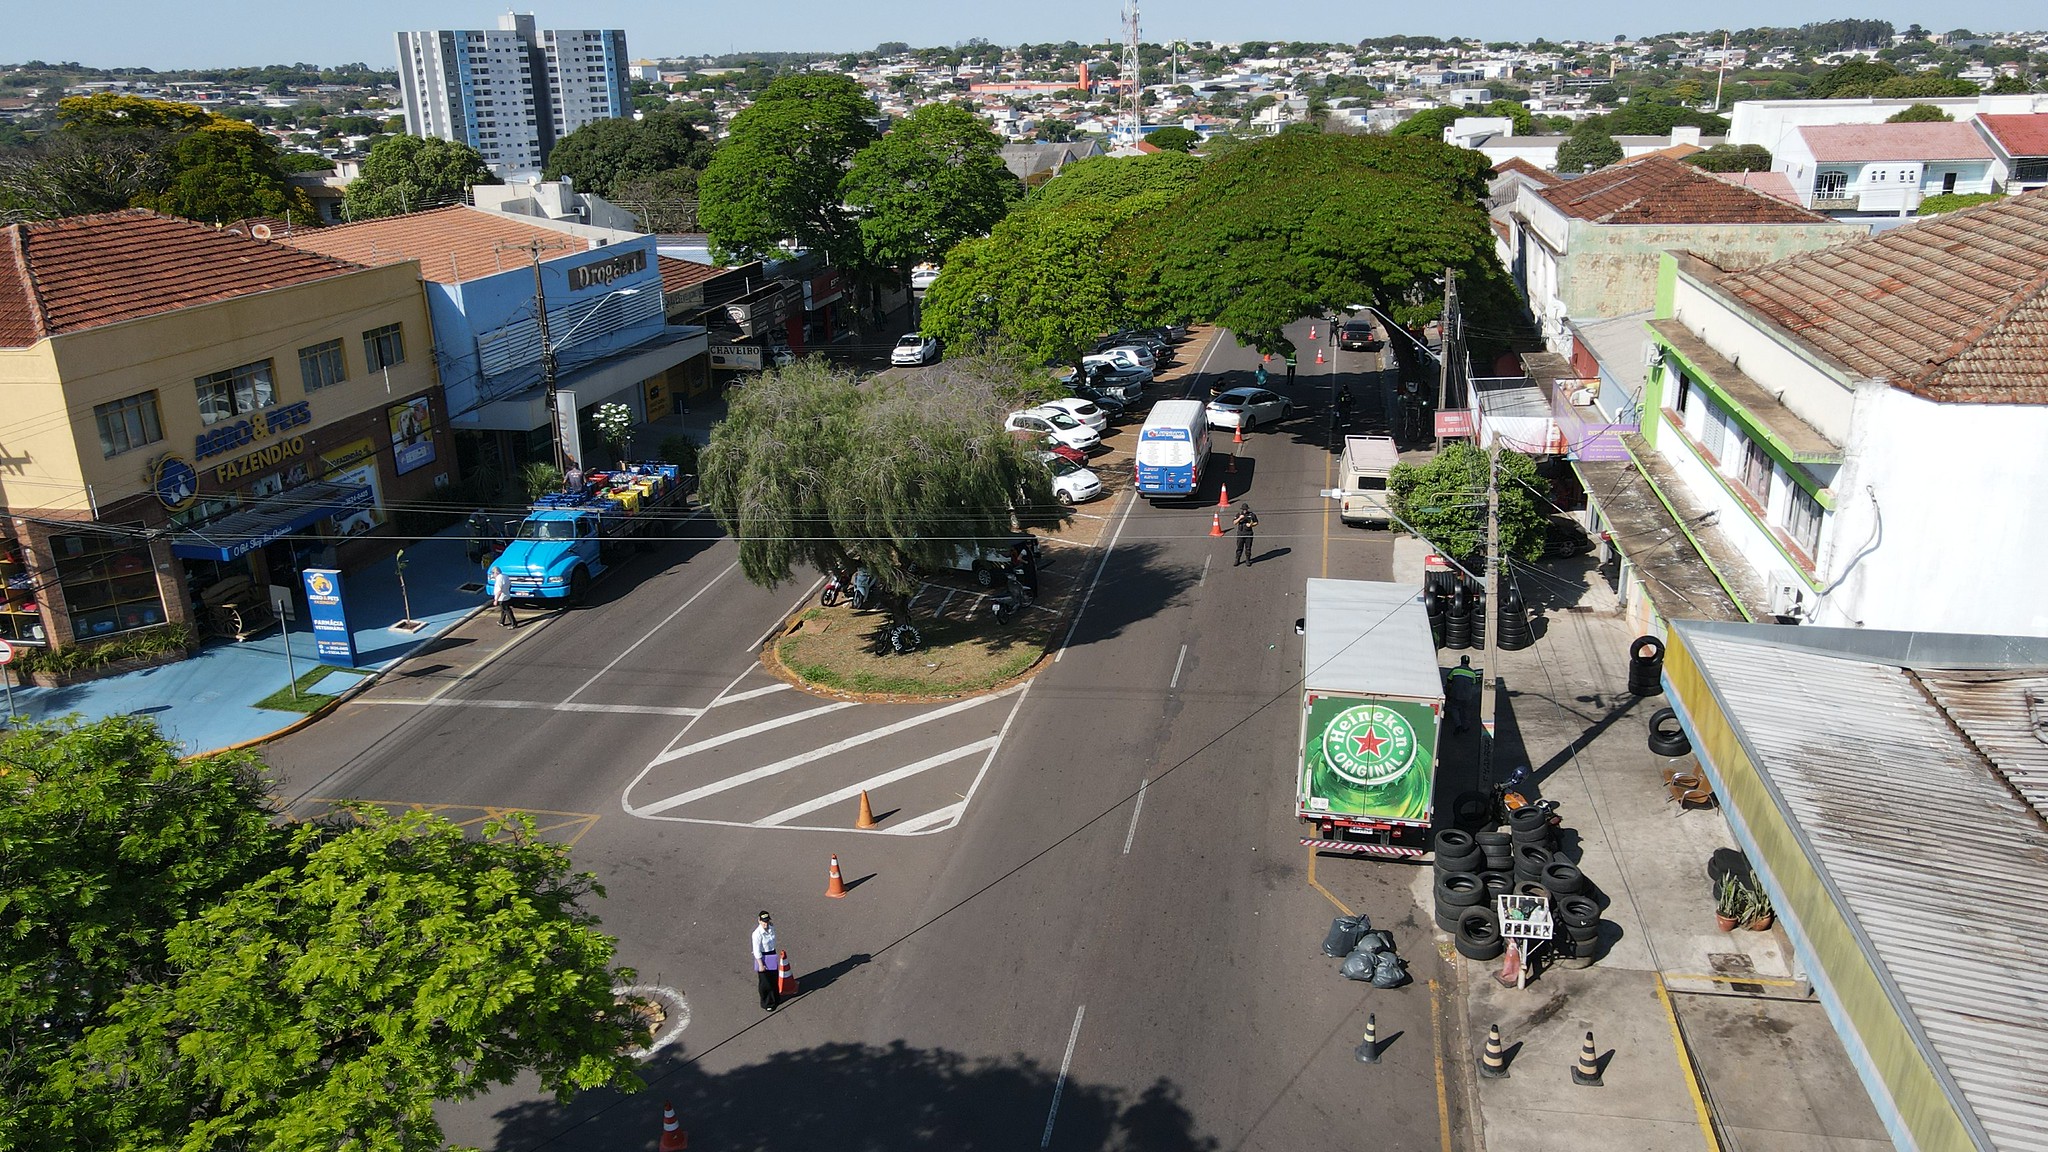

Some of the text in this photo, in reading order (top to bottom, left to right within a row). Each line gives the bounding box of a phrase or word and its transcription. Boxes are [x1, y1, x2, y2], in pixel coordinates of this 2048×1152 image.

[710, 346, 760, 355] CHAVEIRO
[1329, 710, 1408, 747] Heineken
[1334, 751, 1404, 778] ORIGINAL
